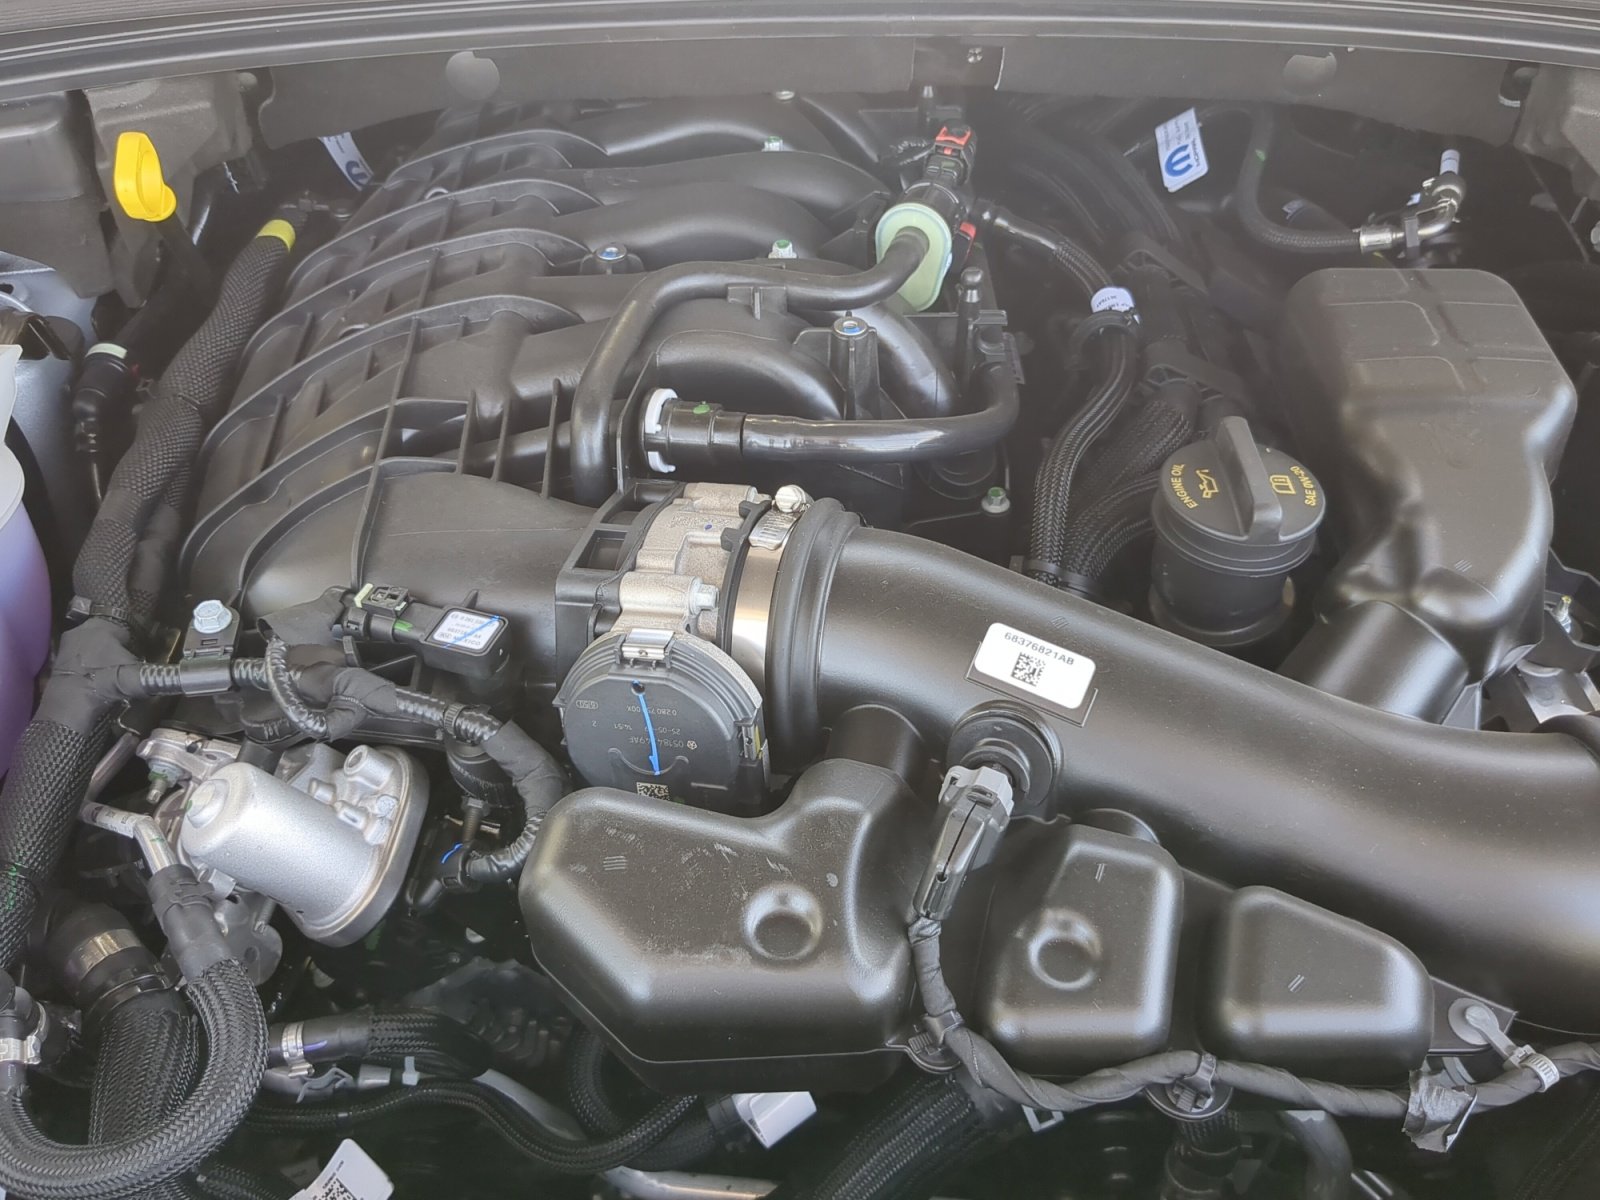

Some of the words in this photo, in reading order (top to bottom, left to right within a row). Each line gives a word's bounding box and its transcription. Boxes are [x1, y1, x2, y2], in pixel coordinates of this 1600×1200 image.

[1171, 463, 1186, 477] OIL
[1171, 477, 1199, 509] ENGINE
[1304, 489, 1317, 507] SAE
[453, 635, 481, 646] MXICO
[1004, 631, 1075, 666] 68376821AB
[629, 735, 684, 749] 0518449AF
